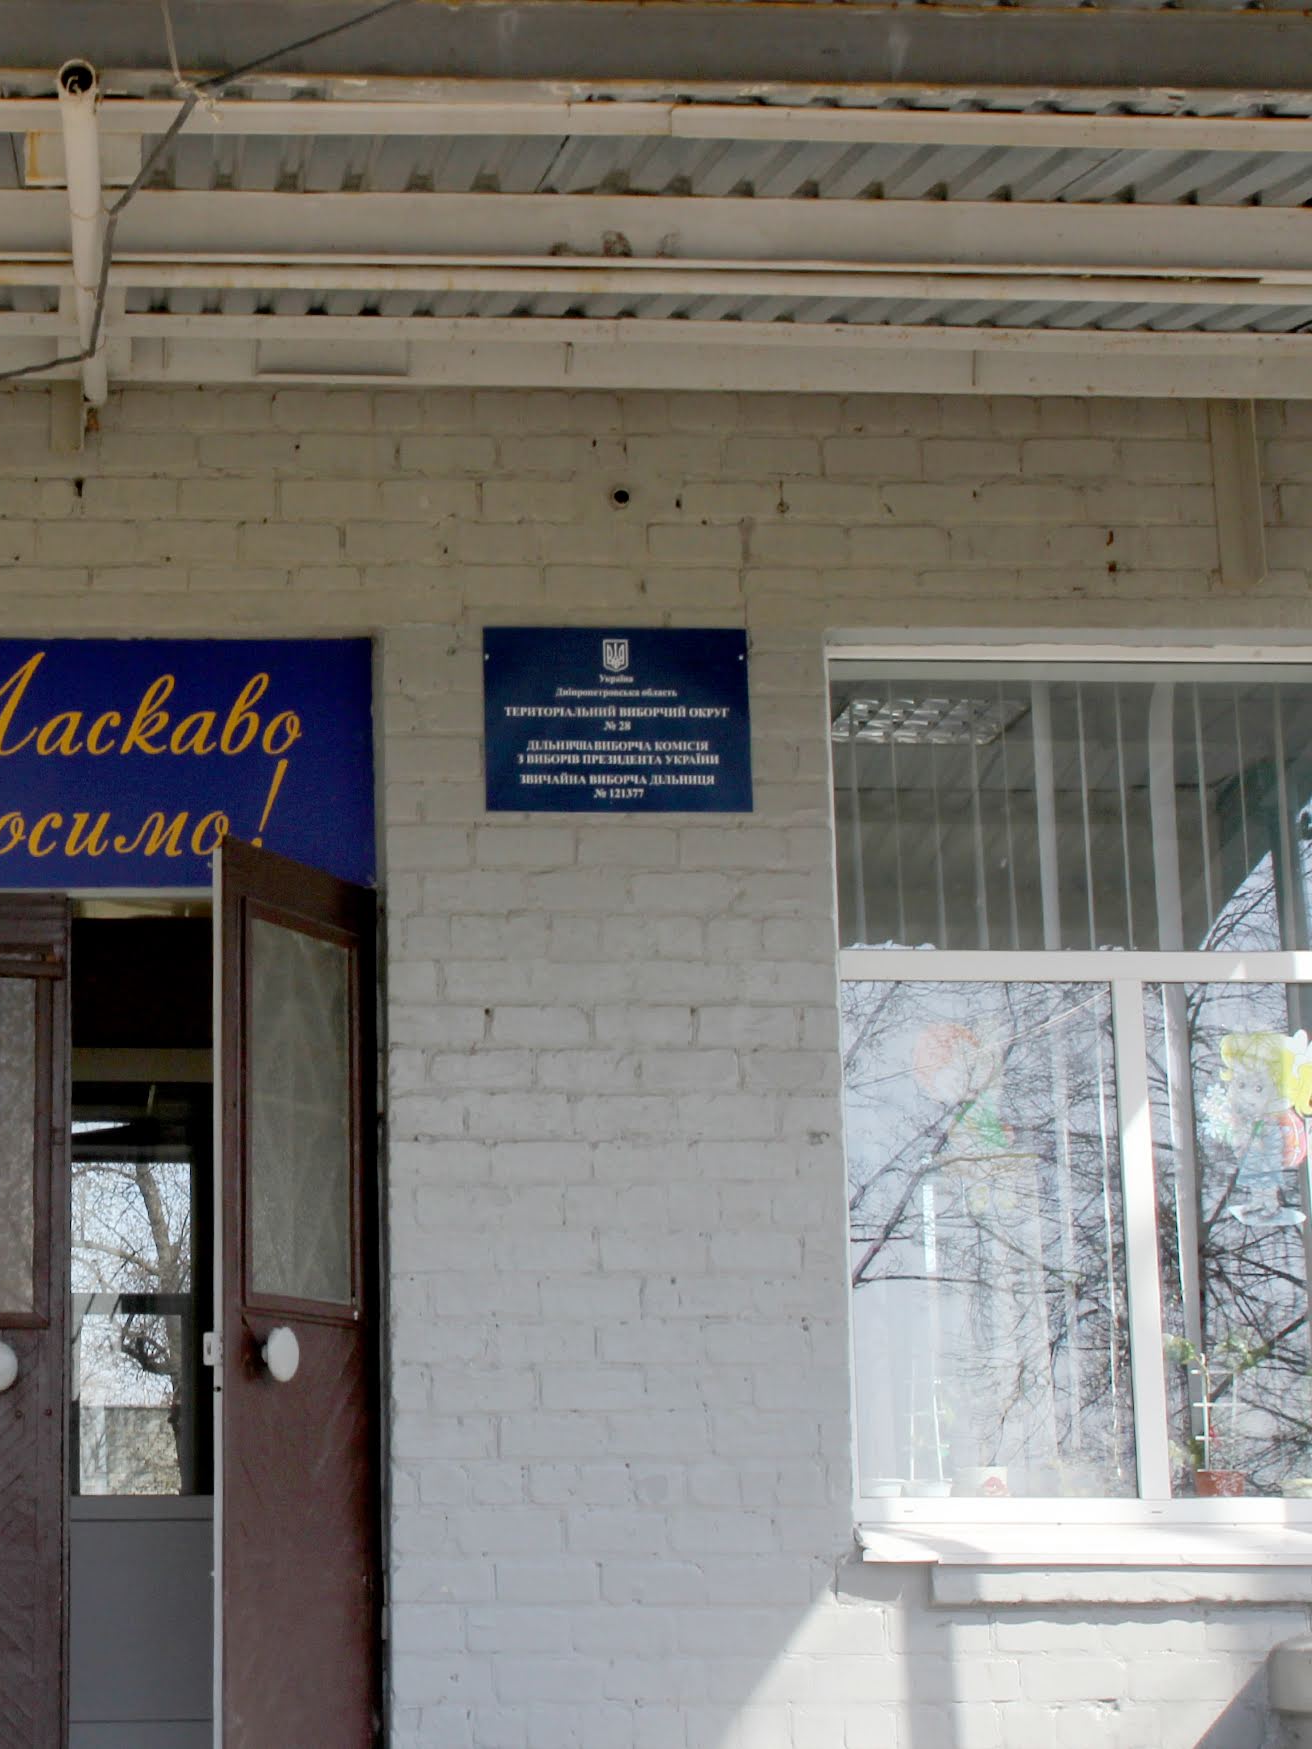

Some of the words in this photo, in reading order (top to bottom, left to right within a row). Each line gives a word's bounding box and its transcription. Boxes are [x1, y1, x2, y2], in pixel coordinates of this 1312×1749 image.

[599, 674, 633, 684] Україна
[555, 688, 639, 698] Дніпропетровська
[641, 688, 677, 697] область
[504, 705, 617, 718] ТЕРИТОРІАЛЬНИЙ
[619, 706, 686, 718] ВИБОРЧИЙ
[689, 707, 729, 718] ОКРУГ
[604, 721, 617, 731] №
[654, 742, 709, 752] КОМІСІЯ
[527, 754, 579, 764] ВИБОРІВ
[582, 755, 662, 766] ПРЕЗИДЕНТА
[666, 753, 719, 765] УКРАЇНИ
[520, 772, 586, 785] ЗВИЧАЙНА
[589, 775, 648, 785] ВИБОРЧА
[650, 775, 714, 786] ДІЛЬНИЦЯ
